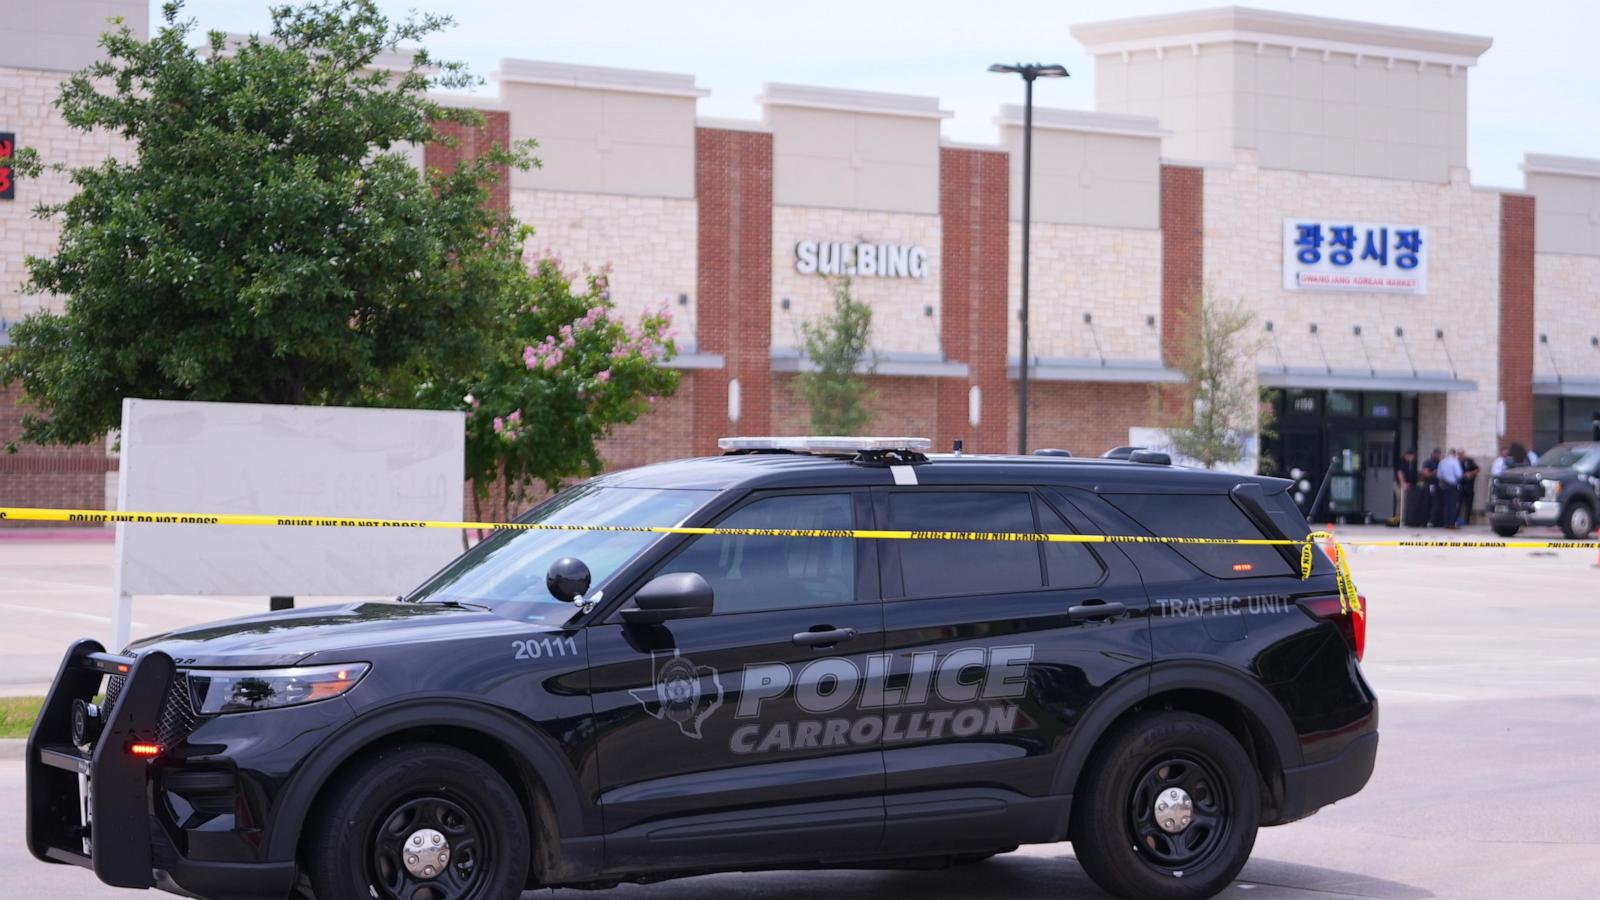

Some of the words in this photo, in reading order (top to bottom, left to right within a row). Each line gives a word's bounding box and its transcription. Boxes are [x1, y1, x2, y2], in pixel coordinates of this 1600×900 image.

[1294, 223, 1422, 269] 광장시장
[1156, 596, 1241, 618] TRAFFIC
[1248, 594, 1291, 615] UNIT
[511, 636, 578, 659] 20111
[735, 643, 1036, 719] POLICE
[729, 706, 1020, 754] CARROLLTON
